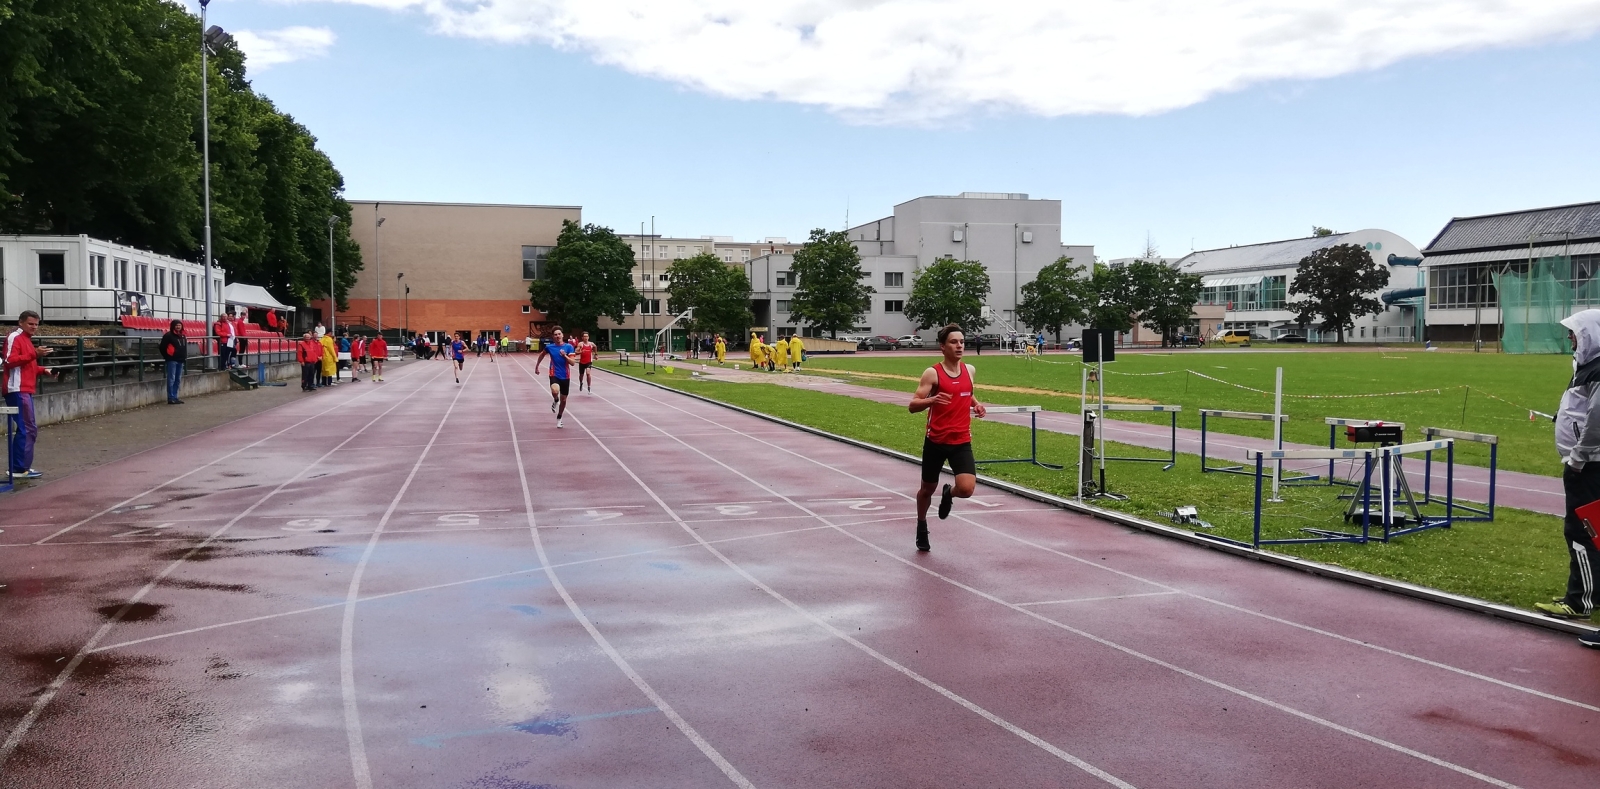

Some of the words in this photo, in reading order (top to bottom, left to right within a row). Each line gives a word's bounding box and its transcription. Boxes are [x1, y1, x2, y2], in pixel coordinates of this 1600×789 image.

[715, 505, 758, 516] 3
[838, 500, 886, 511] 2
[436, 513, 480, 527] 5
[583, 510, 624, 521] 4
